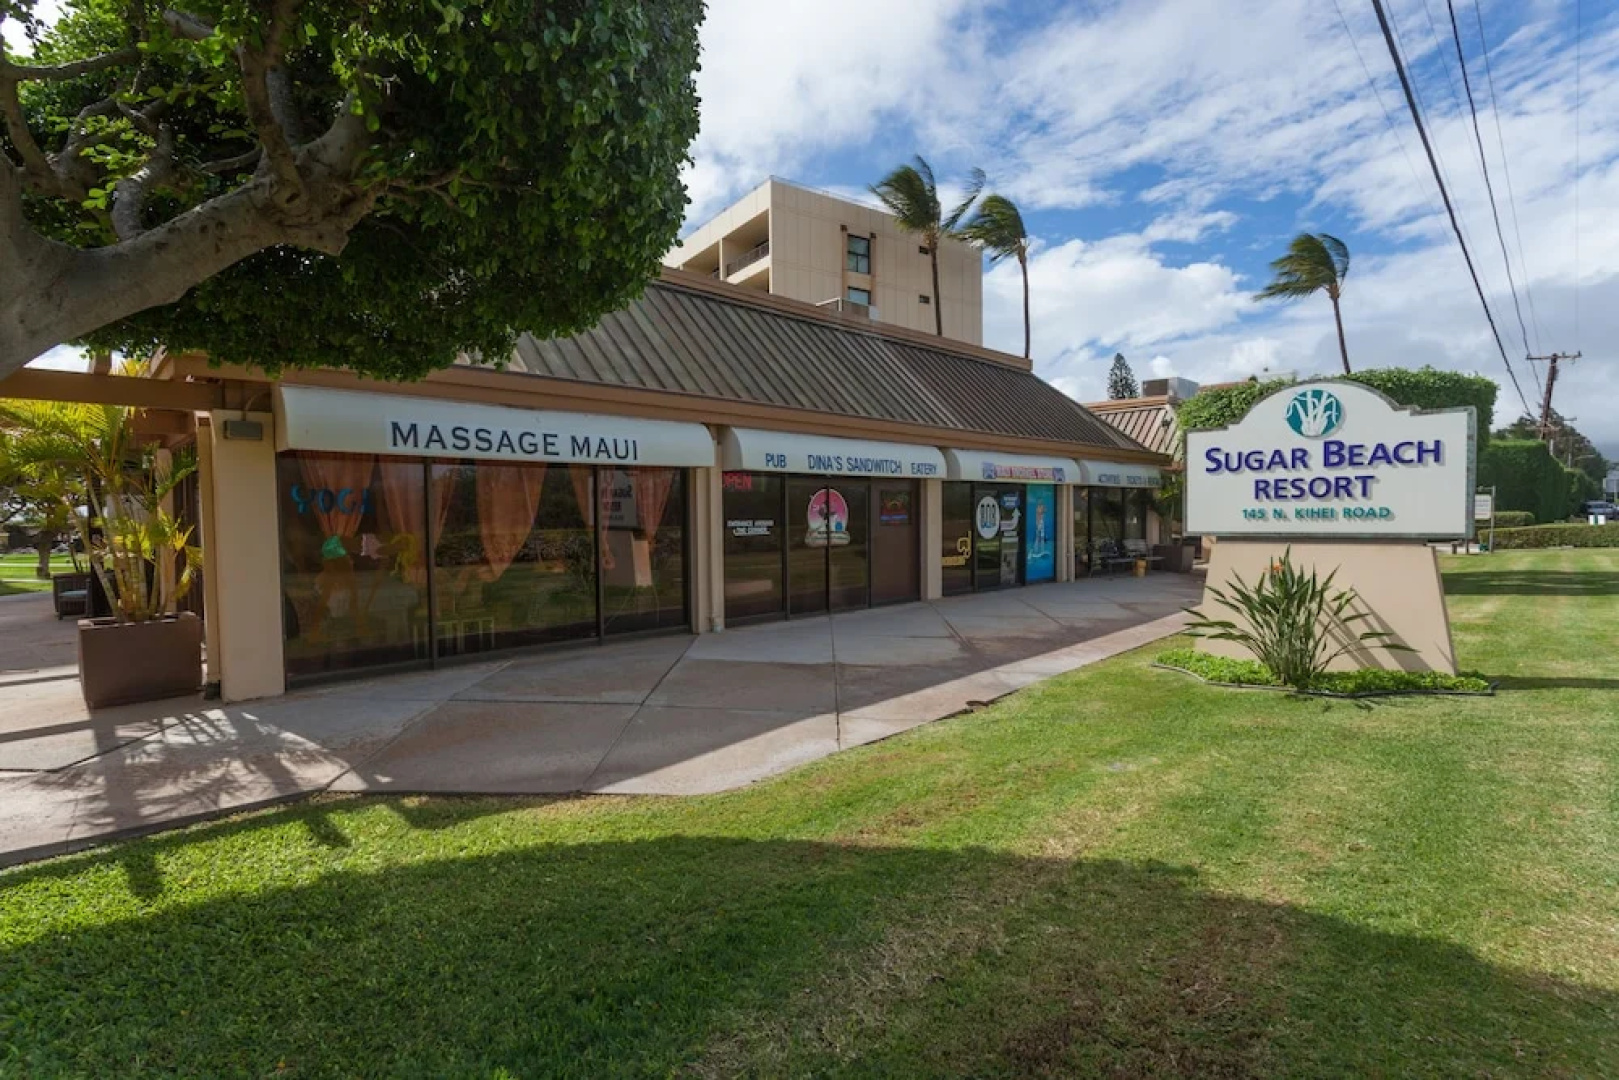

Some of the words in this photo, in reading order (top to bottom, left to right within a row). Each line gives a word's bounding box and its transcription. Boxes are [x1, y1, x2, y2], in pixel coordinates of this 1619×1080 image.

[390, 420, 560, 456] MASSAGE
[570, 434, 638, 461] MAUI
[765, 452, 787, 469] PUB
[808, 454, 843, 471] DINA'S
[846, 457, 902, 474] SANDWITCH
[1205, 447, 1309, 473] SUGAR
[1323, 440, 1442, 468] BEACH
[910, 462, 938, 475] EATERY
[1254, 475, 1375, 500] RESORT
[1242, 508, 1266, 519] 145
[1273, 508, 1288, 519] N.
[1295, 507, 1335, 519] KIHEI
[1343, 506, 1391, 519] ROAD
